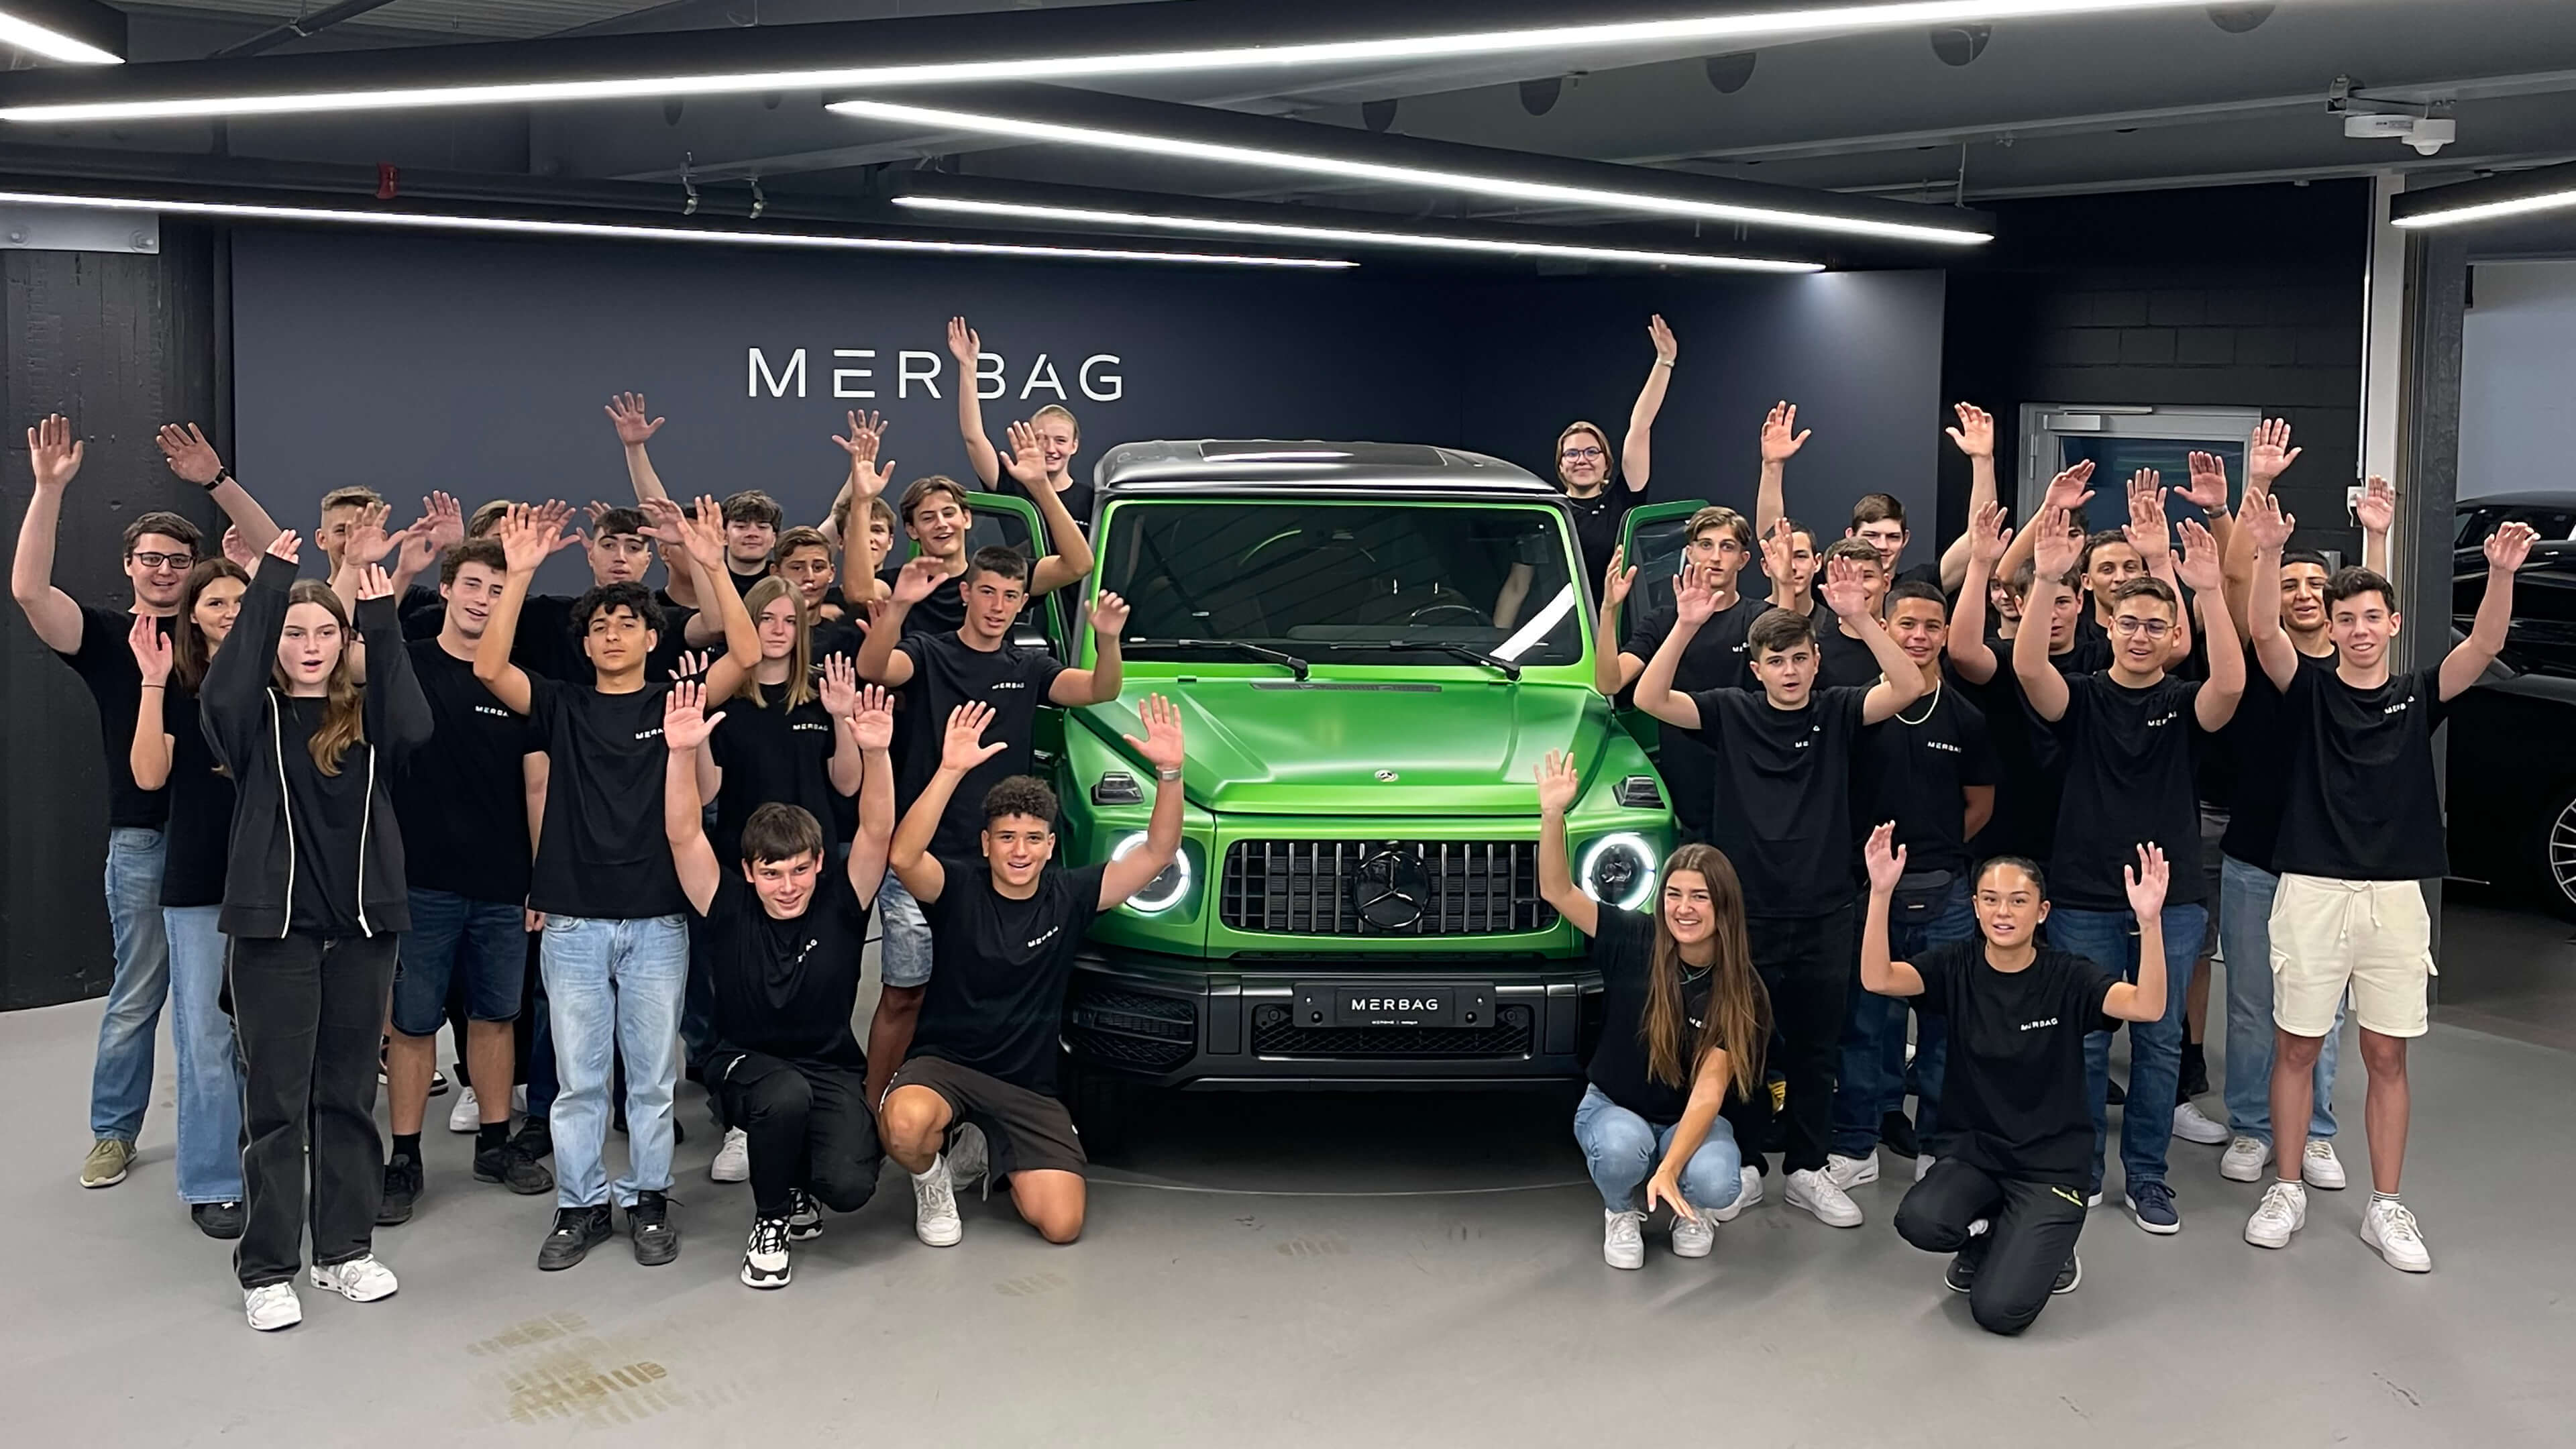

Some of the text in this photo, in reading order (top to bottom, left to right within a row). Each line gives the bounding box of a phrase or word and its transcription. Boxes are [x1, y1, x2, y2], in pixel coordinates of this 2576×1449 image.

[748, 346, 1123, 402] MERBAG
[474, 706, 509, 718] MERBA
[1351, 999, 1439, 1010] MERBAG
